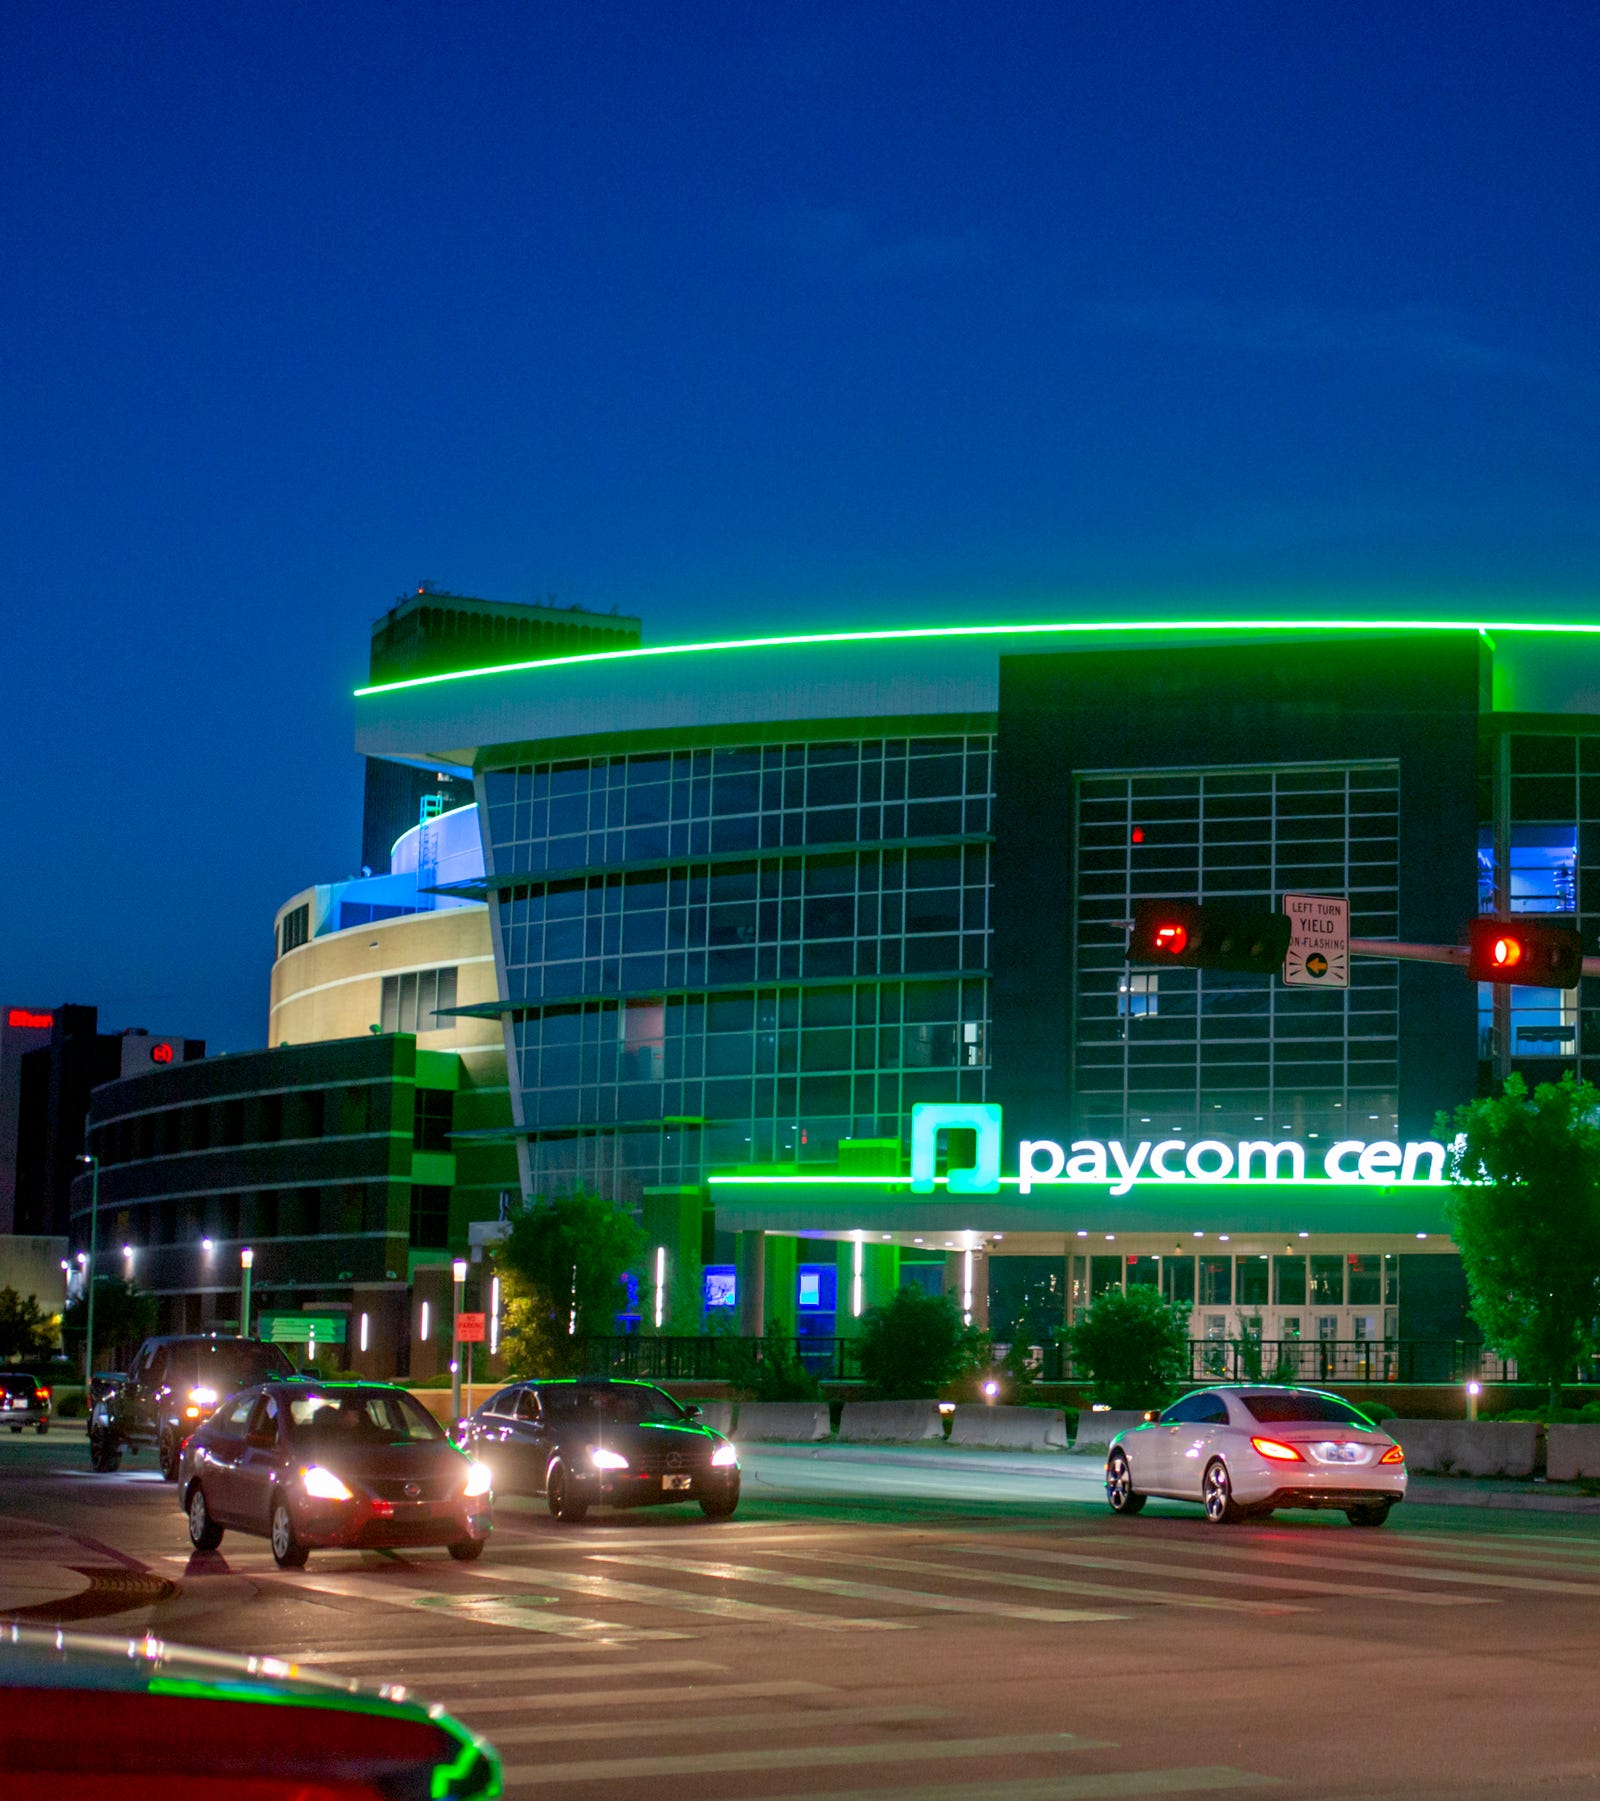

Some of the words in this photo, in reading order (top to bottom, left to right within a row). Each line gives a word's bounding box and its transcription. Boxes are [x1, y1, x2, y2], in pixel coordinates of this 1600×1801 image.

[1292, 902, 1314, 915] LEFT
[1317, 904, 1341, 916] TURN
[1300, 918, 1334, 934] YIELD
[1018, 1138, 1306, 1196] paycom
